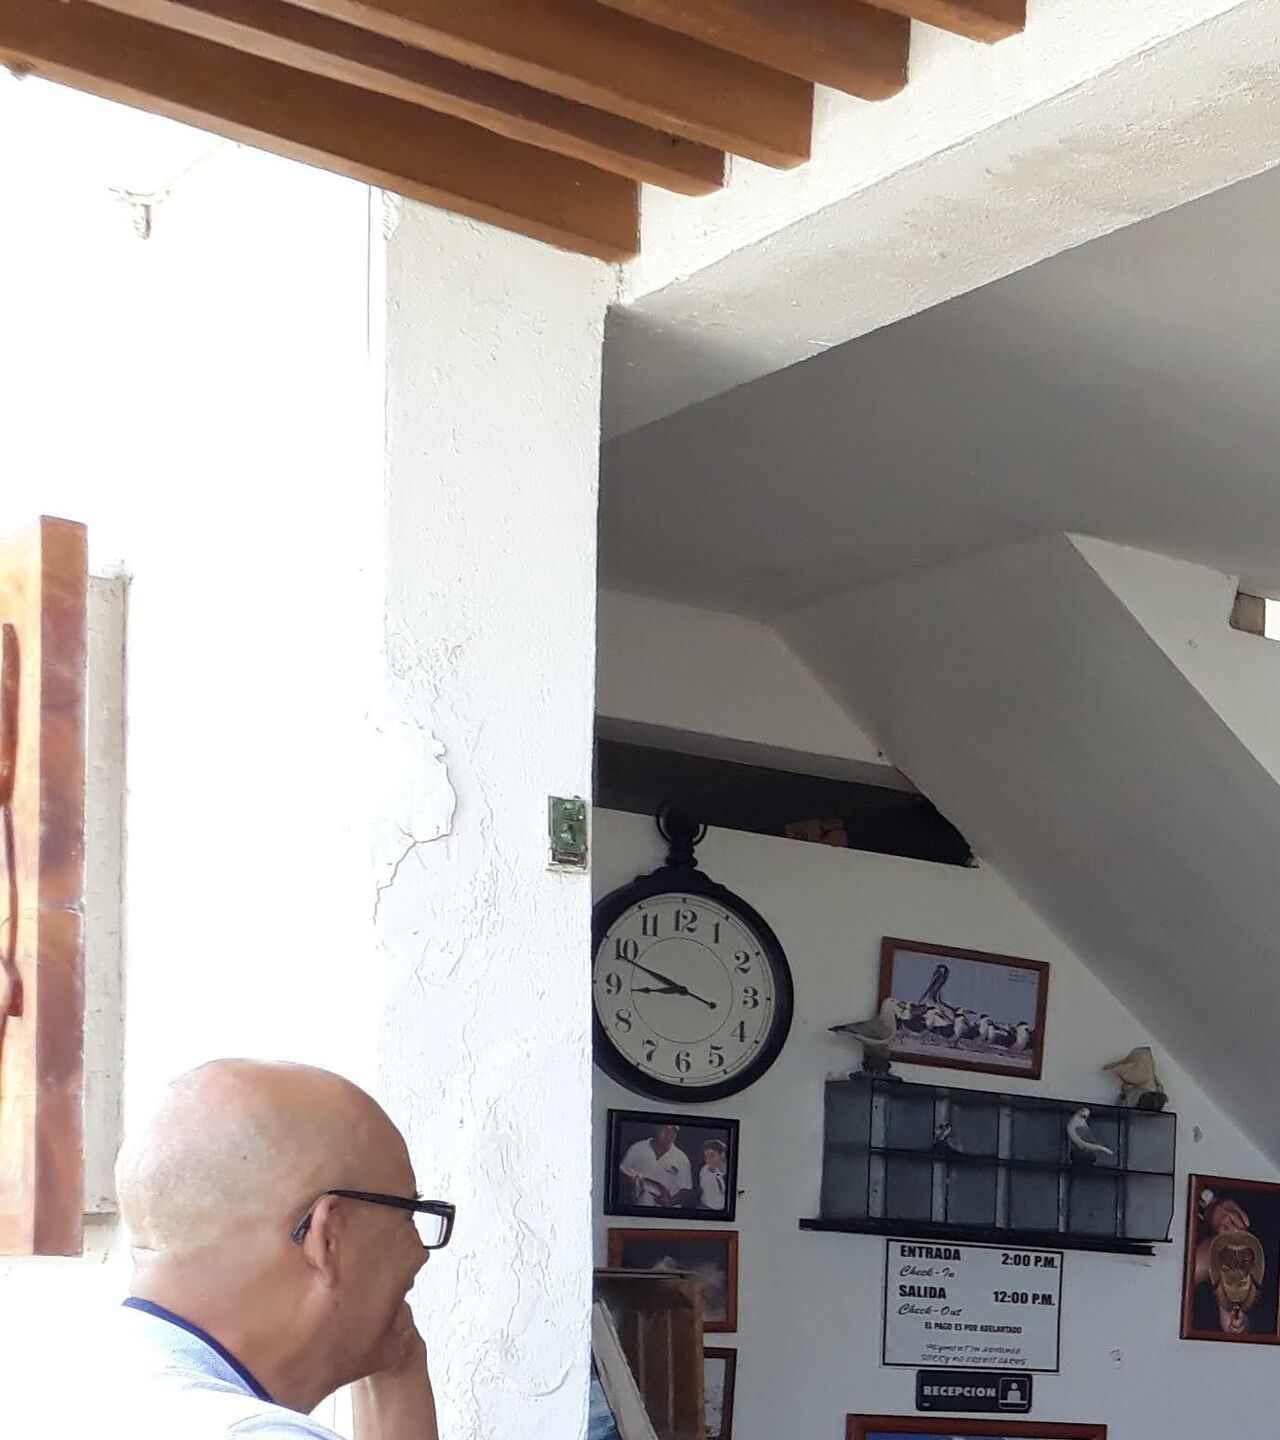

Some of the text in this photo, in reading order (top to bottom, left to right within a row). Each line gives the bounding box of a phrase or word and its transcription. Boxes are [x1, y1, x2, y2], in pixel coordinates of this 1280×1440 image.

[641, 913, 659, 937] 11
[674, 908, 698, 934] 12
[713, 922, 721, 944] 1
[614, 938, 639, 962] 10
[734, 951, 750, 974] 2
[605, 973, 623, 995] 9
[743, 987, 760, 1010] 3
[615, 1008, 632, 1034] 8
[731, 1020, 748, 1043] 4
[642, 1039, 658, 1062] 7
[675, 1050, 692, 1073] 6
[709, 1045, 725, 1069] 5
[900, 1245, 1058, 1268] ENTRADA 2:00 P.M.
[898, 1285, 1056, 1306] SALIDA 12:00 P.M.
[934, 1322, 952, 1331] PAGO
[964, 1324, 978, 1332] POR
[979, 1324, 1023, 1334] ADELANTADO
[923, 1384, 996, 1398] RECEPCION
